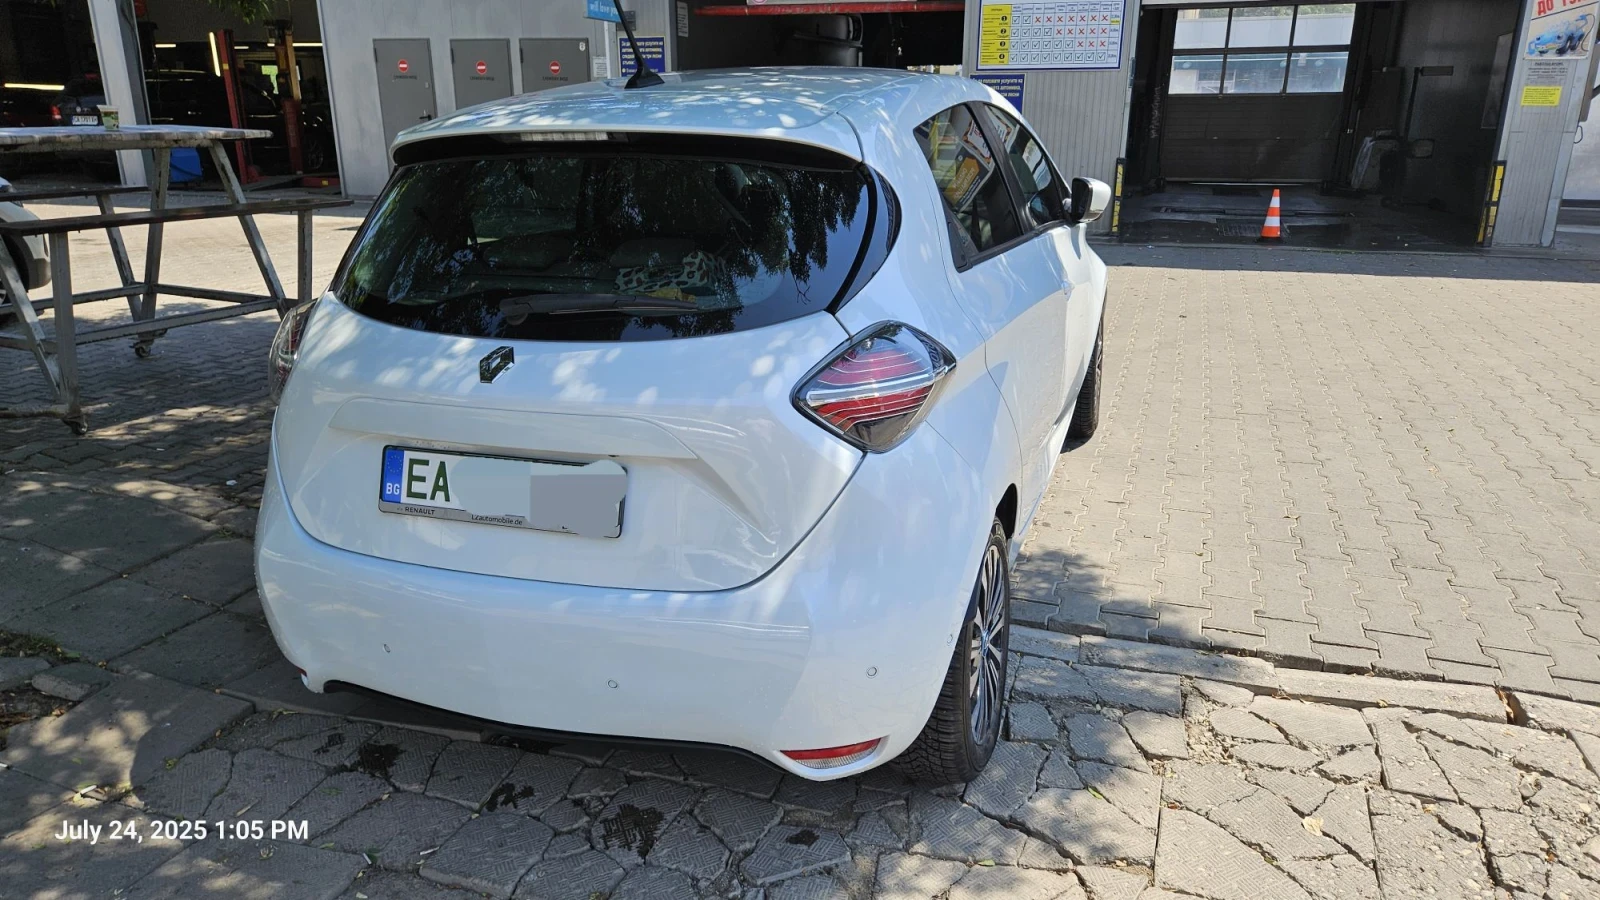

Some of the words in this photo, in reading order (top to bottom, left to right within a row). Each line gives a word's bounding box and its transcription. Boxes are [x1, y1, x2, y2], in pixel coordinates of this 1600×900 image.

[590, 0, 598, 11] will
[599, 1, 609, 13] love
[406, 458, 450, 502] EA
[386, 483, 400, 495] BG
[405, 506, 435, 515] RENAULT
